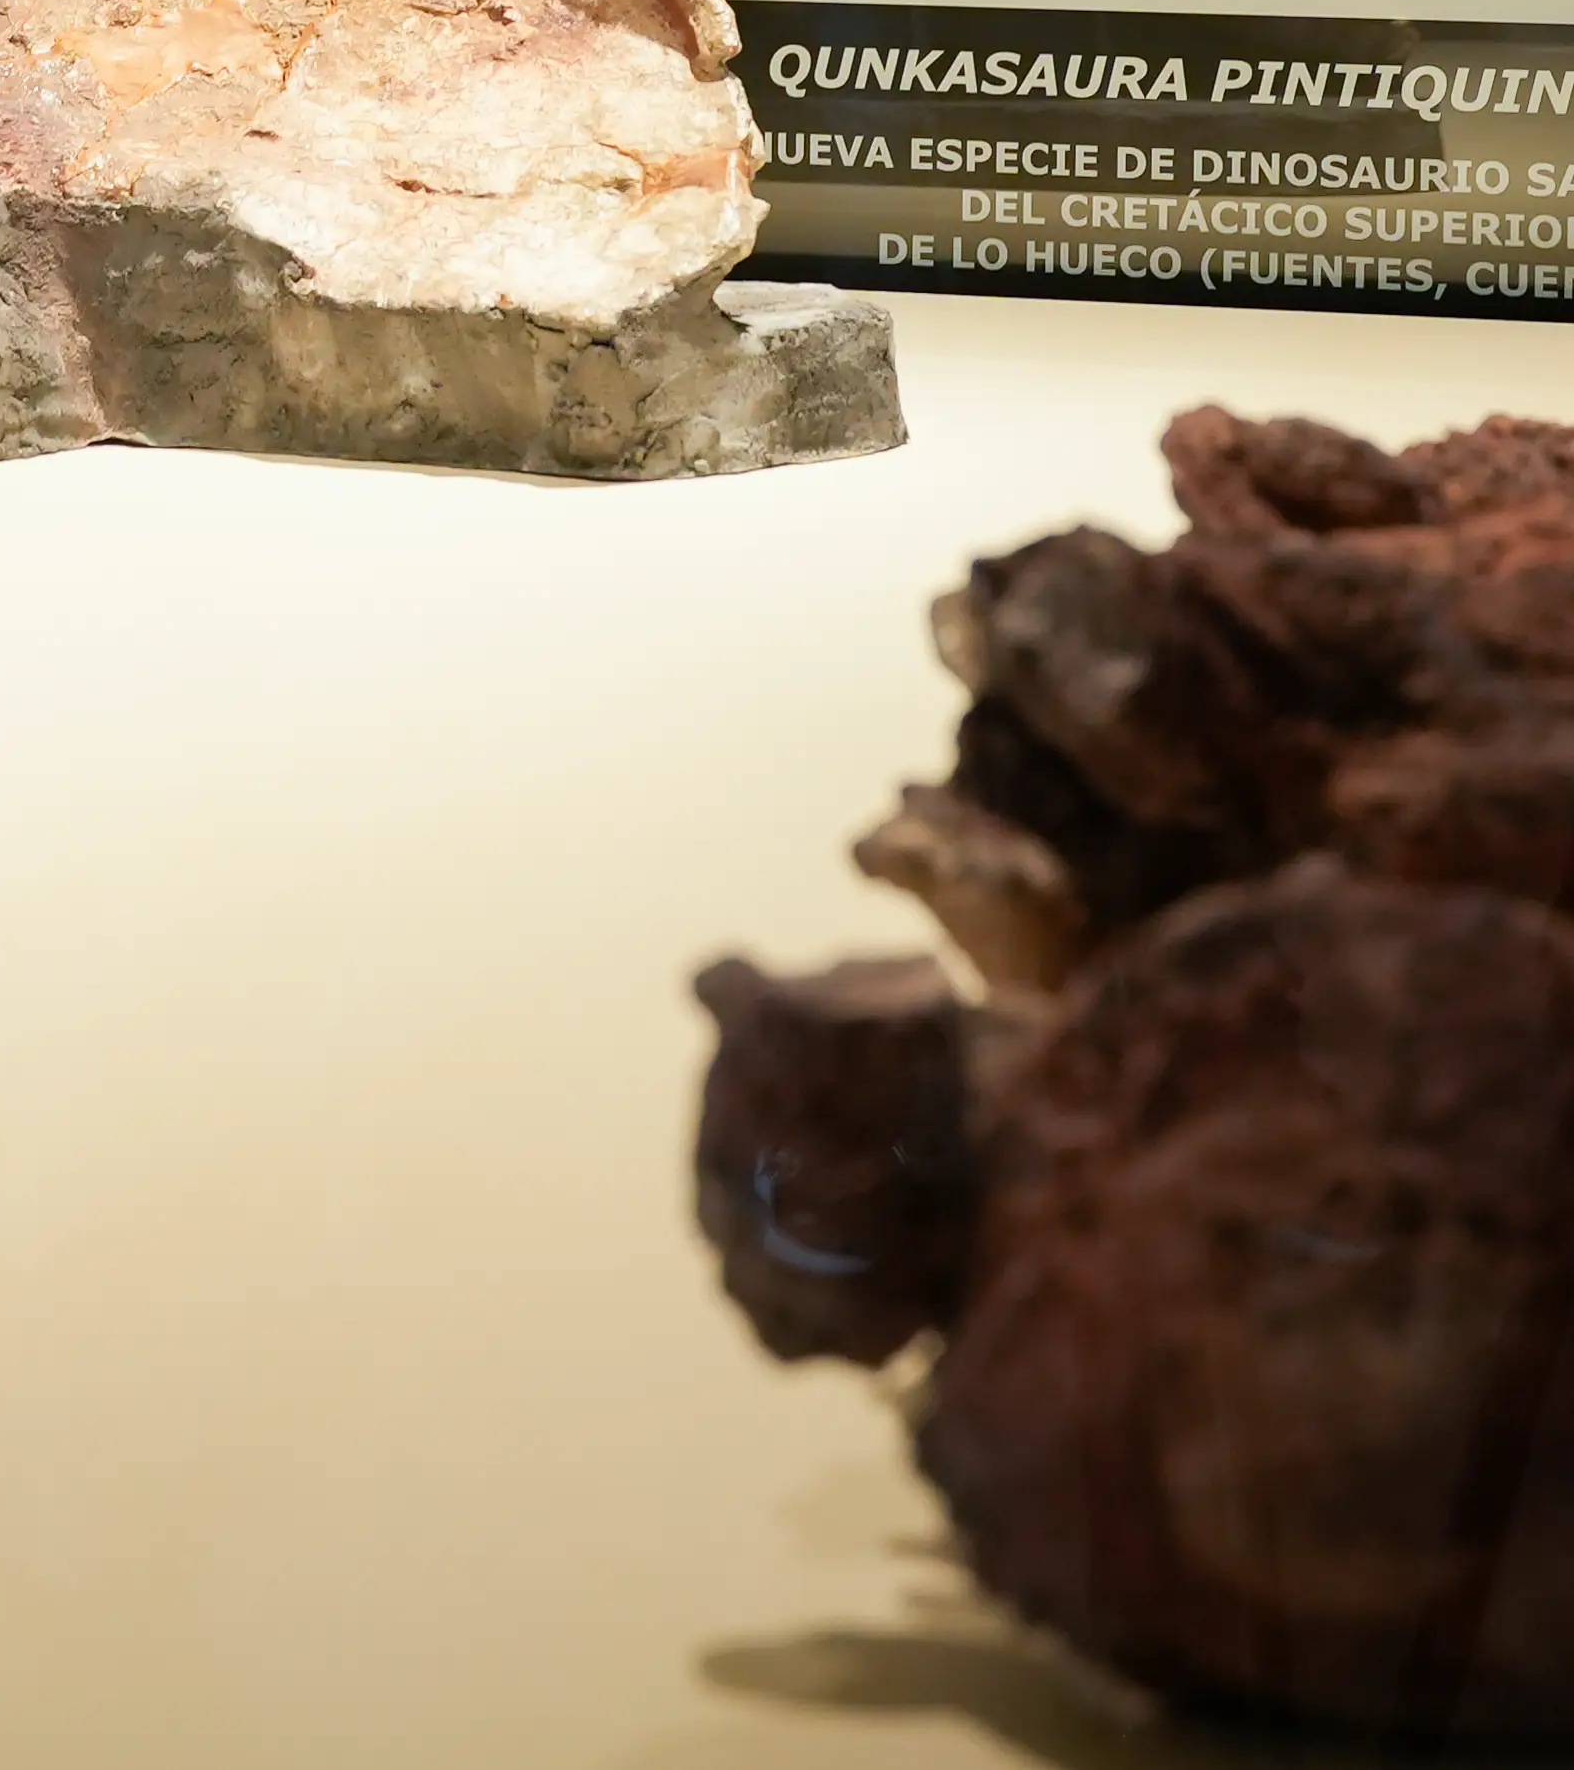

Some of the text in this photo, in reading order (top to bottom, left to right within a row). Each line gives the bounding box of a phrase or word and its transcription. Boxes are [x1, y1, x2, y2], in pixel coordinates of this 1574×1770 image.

[769, 44, 1188, 101] QUNKASAURA
[910, 137, 1099, 177] ESPECIE
[1116, 147, 1175, 181] DE
[1193, 149, 1510, 194] DINOSAURIO
[961, 189, 1046, 225] DEL
[1061, 188, 1327, 238] CRETÁCICO
[878, 232, 935, 267] DE
[952, 236, 1008, 271] LO
[1025, 240, 1182, 280] HUECO
[1200, 247, 1448, 301] (FUENTES,
